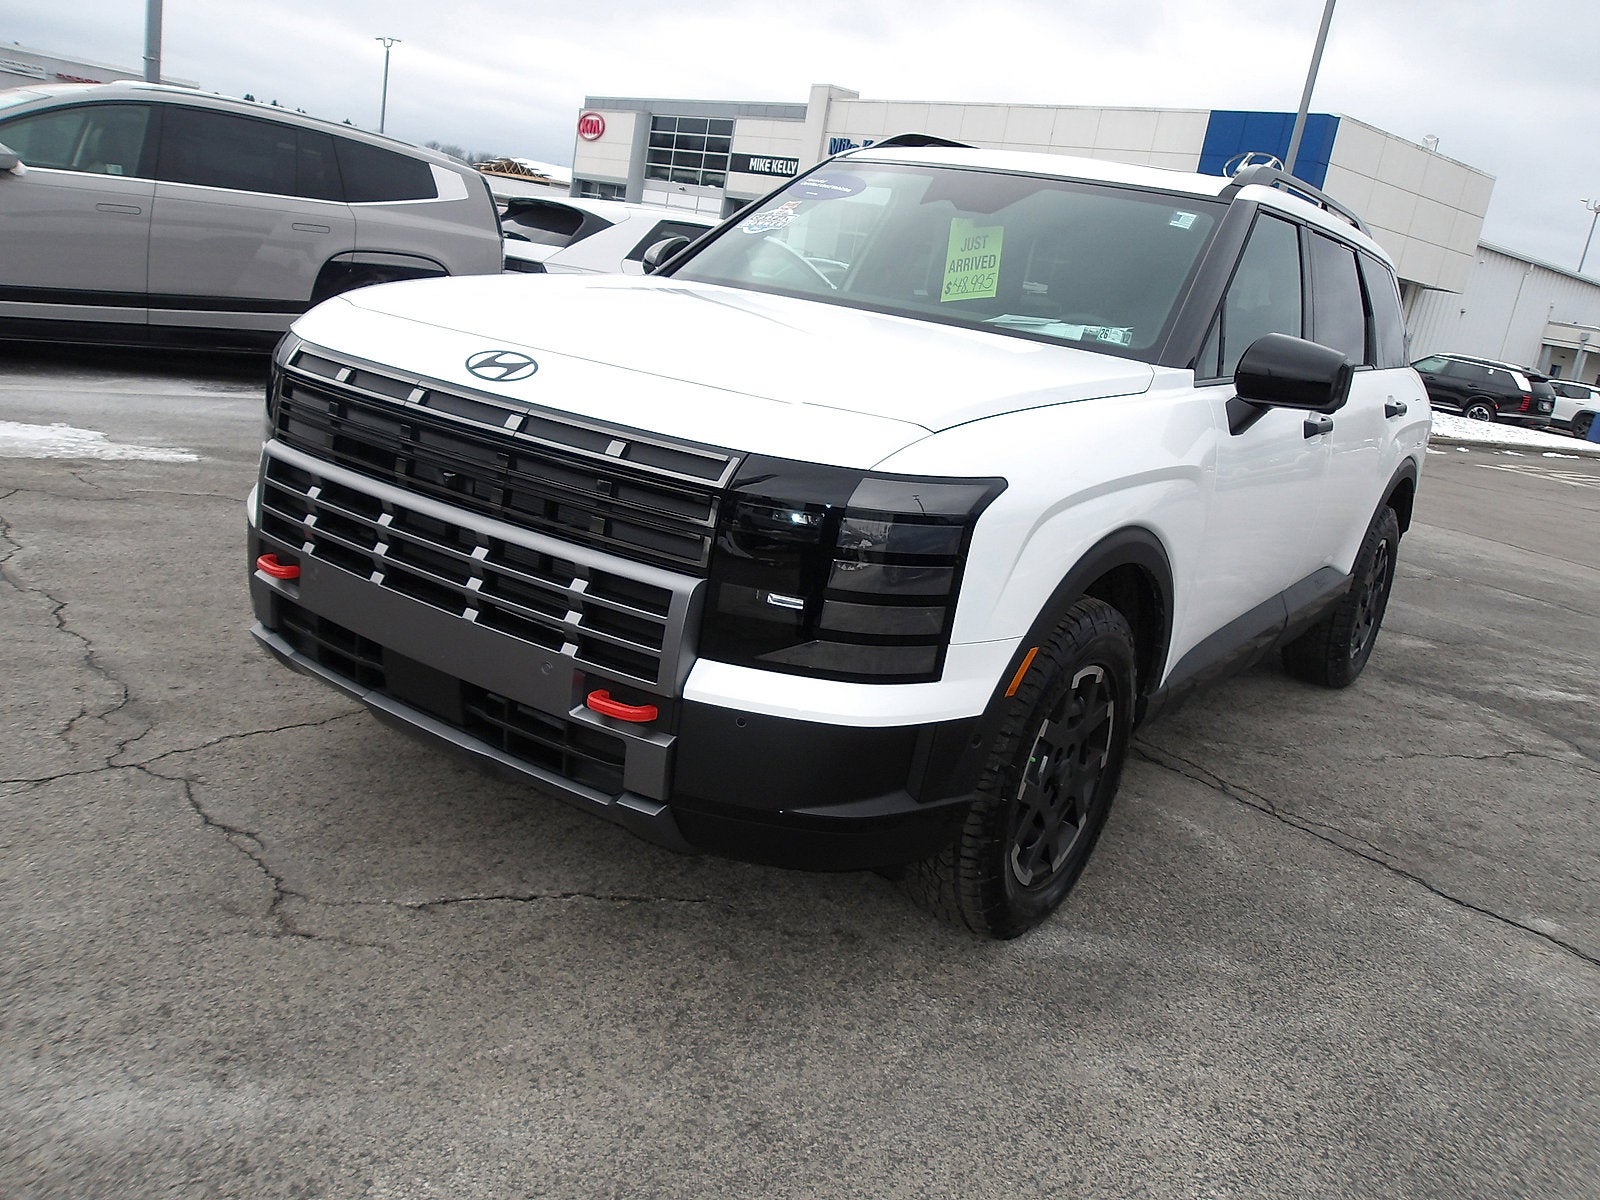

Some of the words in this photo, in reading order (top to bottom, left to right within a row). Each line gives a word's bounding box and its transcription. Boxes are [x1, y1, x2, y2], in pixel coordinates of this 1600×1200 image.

[581, 118, 600, 134] KIA
[749, 157, 771, 172] MIKE
[771, 159, 798, 175] KELLY
[960, 235, 989, 252] JUST
[948, 254, 997, 274] ARRIVED
[1100, 328, 1110, 339] 26
